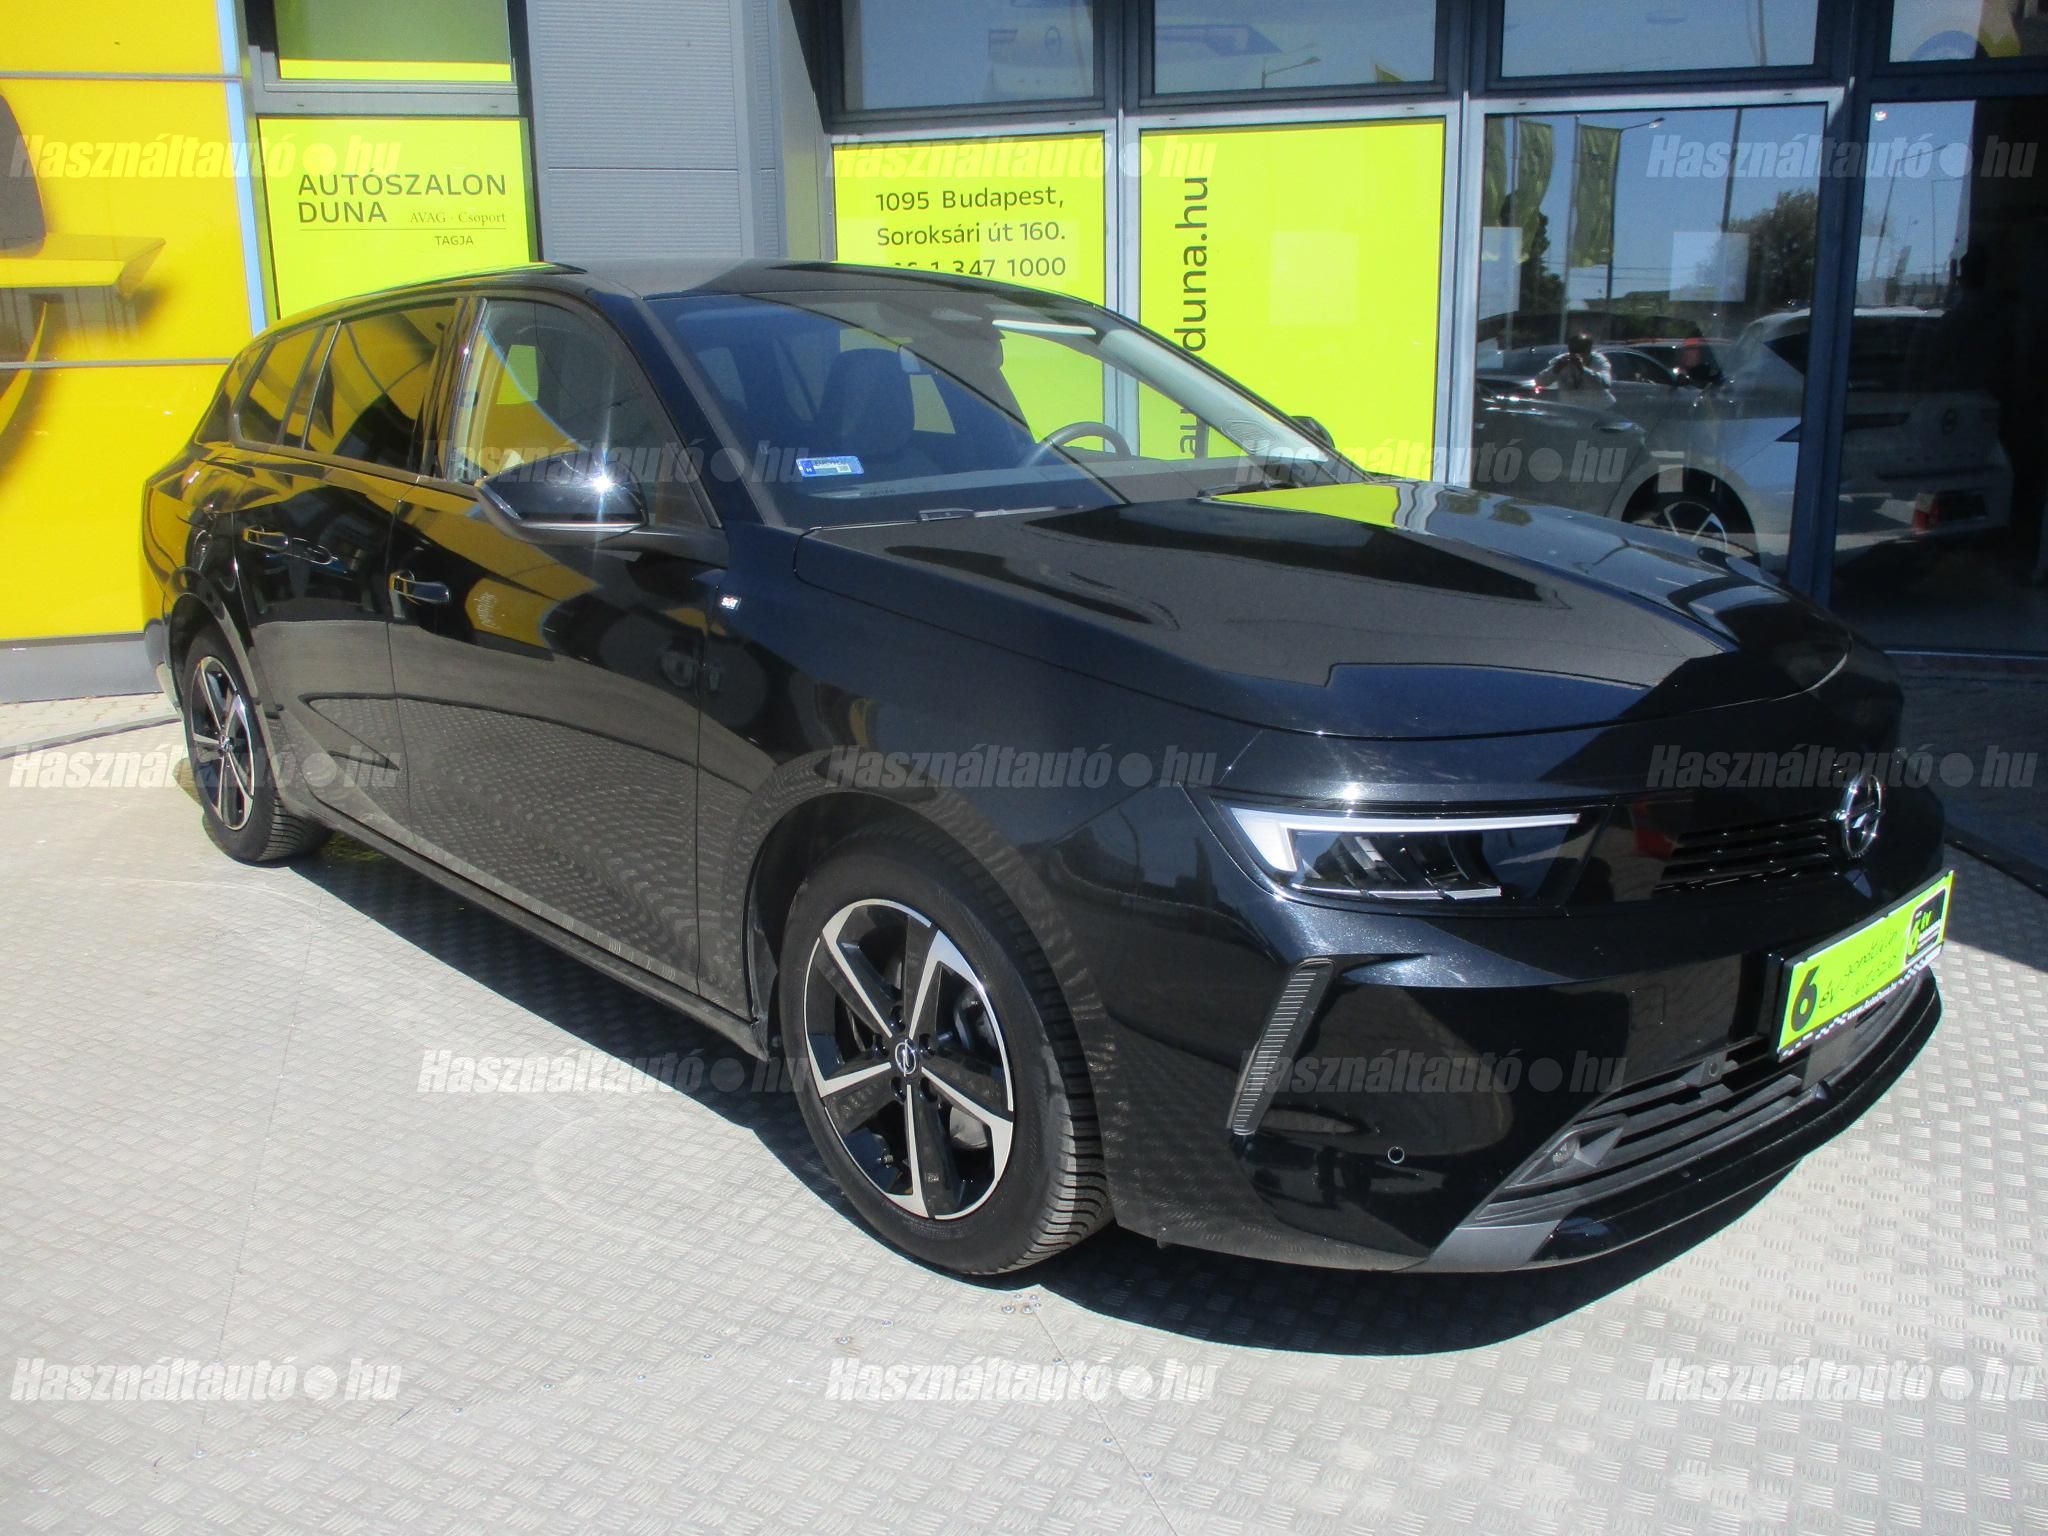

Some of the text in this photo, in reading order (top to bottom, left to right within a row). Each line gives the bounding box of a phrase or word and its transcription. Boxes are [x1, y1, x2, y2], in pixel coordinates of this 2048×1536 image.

[298, 168, 506, 196] AUTÓSZALON
[875, 185, 1064, 212] 1095 Budapest,
[298, 201, 388, 223] DUNA
[410, 210, 506, 227] AVAG Csoport
[434, 235, 474, 246] TAGJA
[876, 220, 1066, 247] Soroksári út 160.
[1007, 256, 1067, 278] 1000
[1791, 965, 1820, 1032] 6
